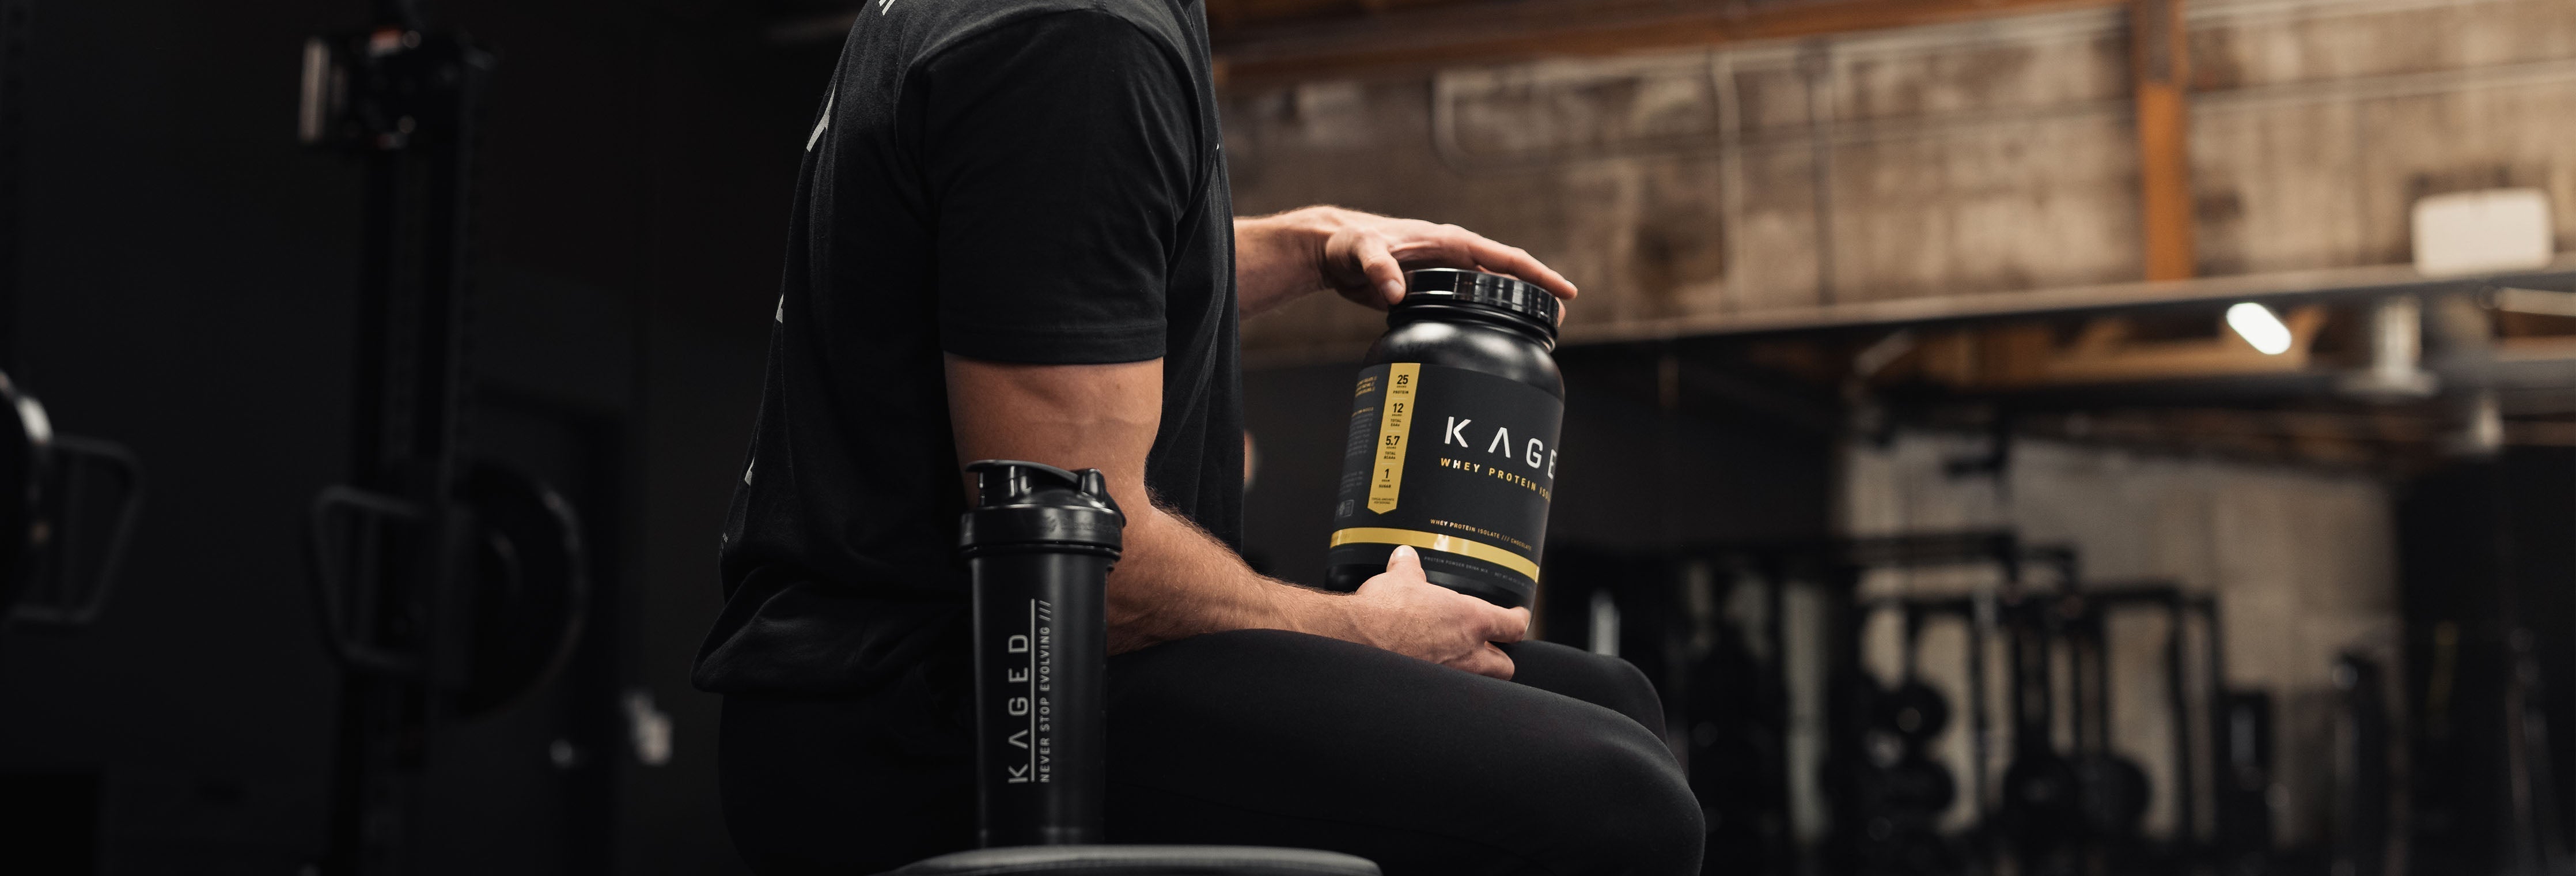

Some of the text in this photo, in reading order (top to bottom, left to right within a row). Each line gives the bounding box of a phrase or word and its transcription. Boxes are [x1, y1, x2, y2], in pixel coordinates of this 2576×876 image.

[1397, 374, 1409, 384] 25
[1393, 403, 1404, 413] 12
[1385, 436, 1400, 445] 5.7
[1384, 468, 1389, 478] 1
[1441, 458, 1480, 473] WHEY
[1488, 467, 1537, 491] PROTEIN
[1449, 522, 1476, 533] PROTEIN
[1478, 528, 1500, 538] ISOLATE
[1510, 538, 1532, 551] CHOCOLATE
[1039, 626, 1050, 692] EVOLVING
[1008, 634, 1029, 783] KAGED
[1039, 697, 1050, 732] STOP
[1039, 737, 1050, 783] NEVER
